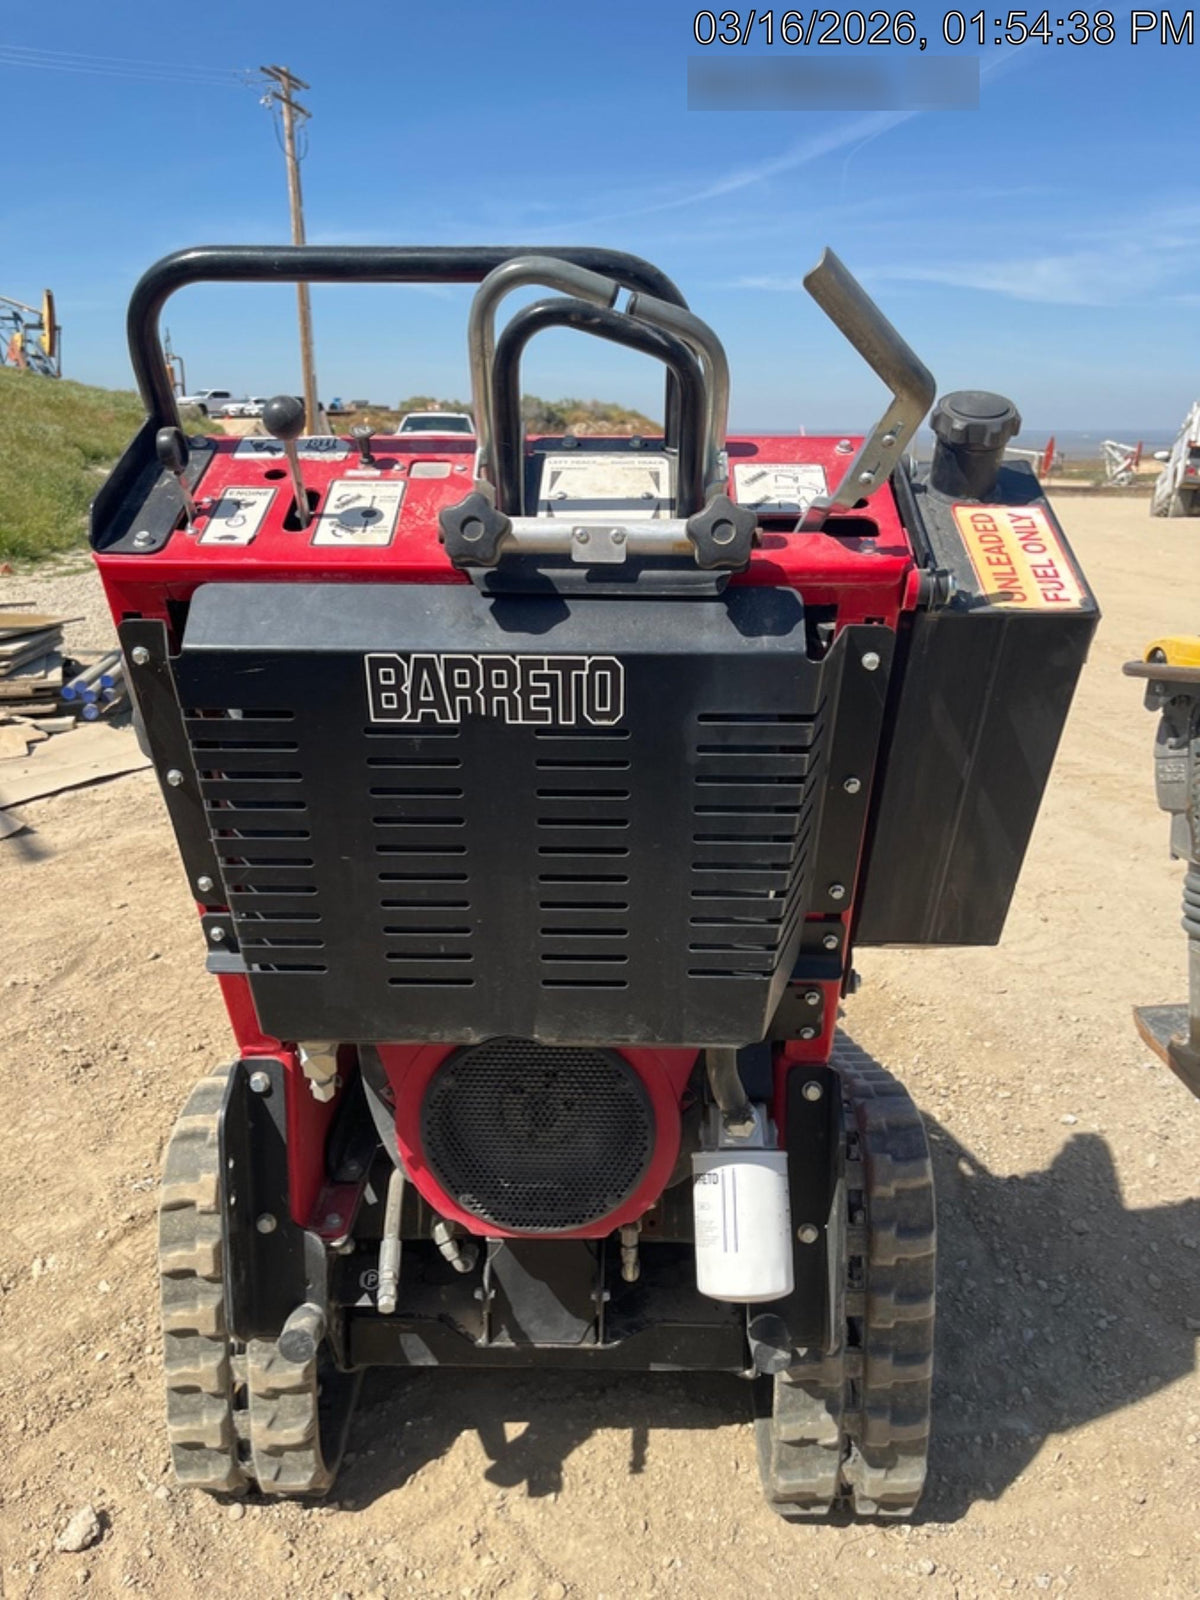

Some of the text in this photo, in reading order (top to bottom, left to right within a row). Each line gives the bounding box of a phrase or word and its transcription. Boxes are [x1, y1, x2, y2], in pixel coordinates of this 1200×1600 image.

[970, 512, 1028, 604] UNLEADED
[1008, 512, 1071, 604] FUEL ONLY
[364, 653, 625, 725] BARRETO
